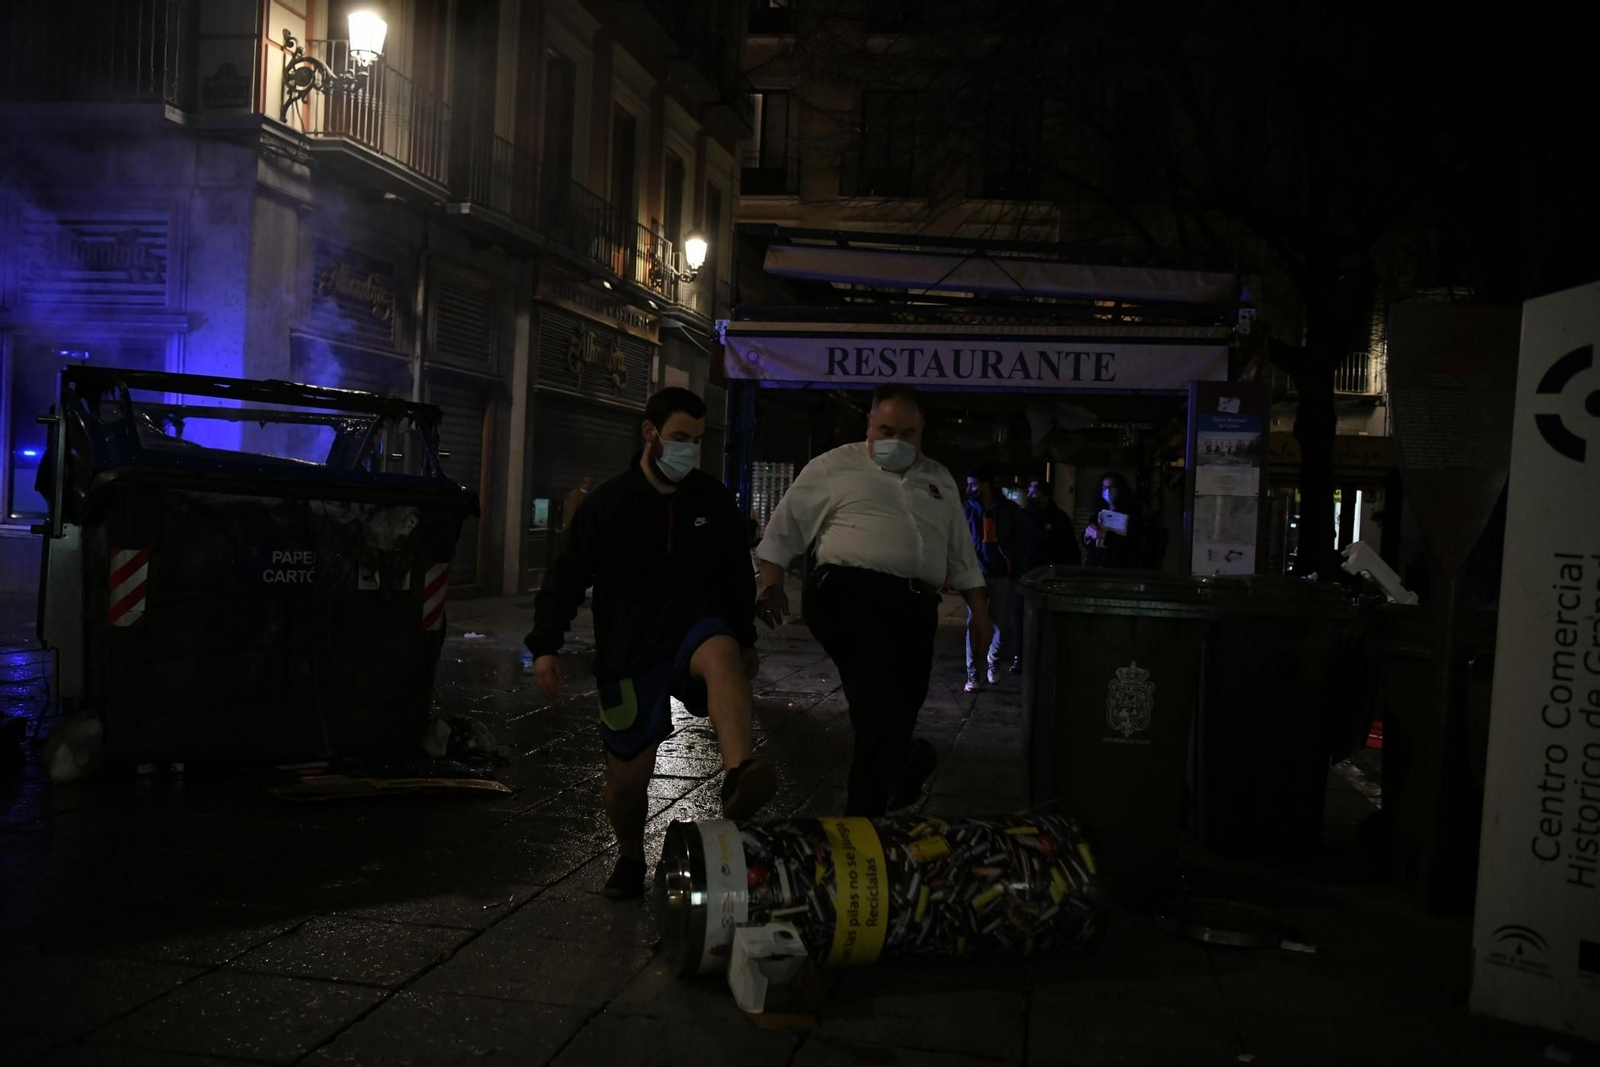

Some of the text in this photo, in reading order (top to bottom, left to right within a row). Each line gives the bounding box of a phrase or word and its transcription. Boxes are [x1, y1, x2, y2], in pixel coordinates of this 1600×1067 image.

[826, 346, 1117, 382] RESTAURANTE
[1532, 552, 1584, 862] Centro Comercial
[1566, 743, 1600, 888] Historico
[845, 853, 857, 867] se
[848, 870, 859, 889] no
[846, 893, 861, 927] pilas
